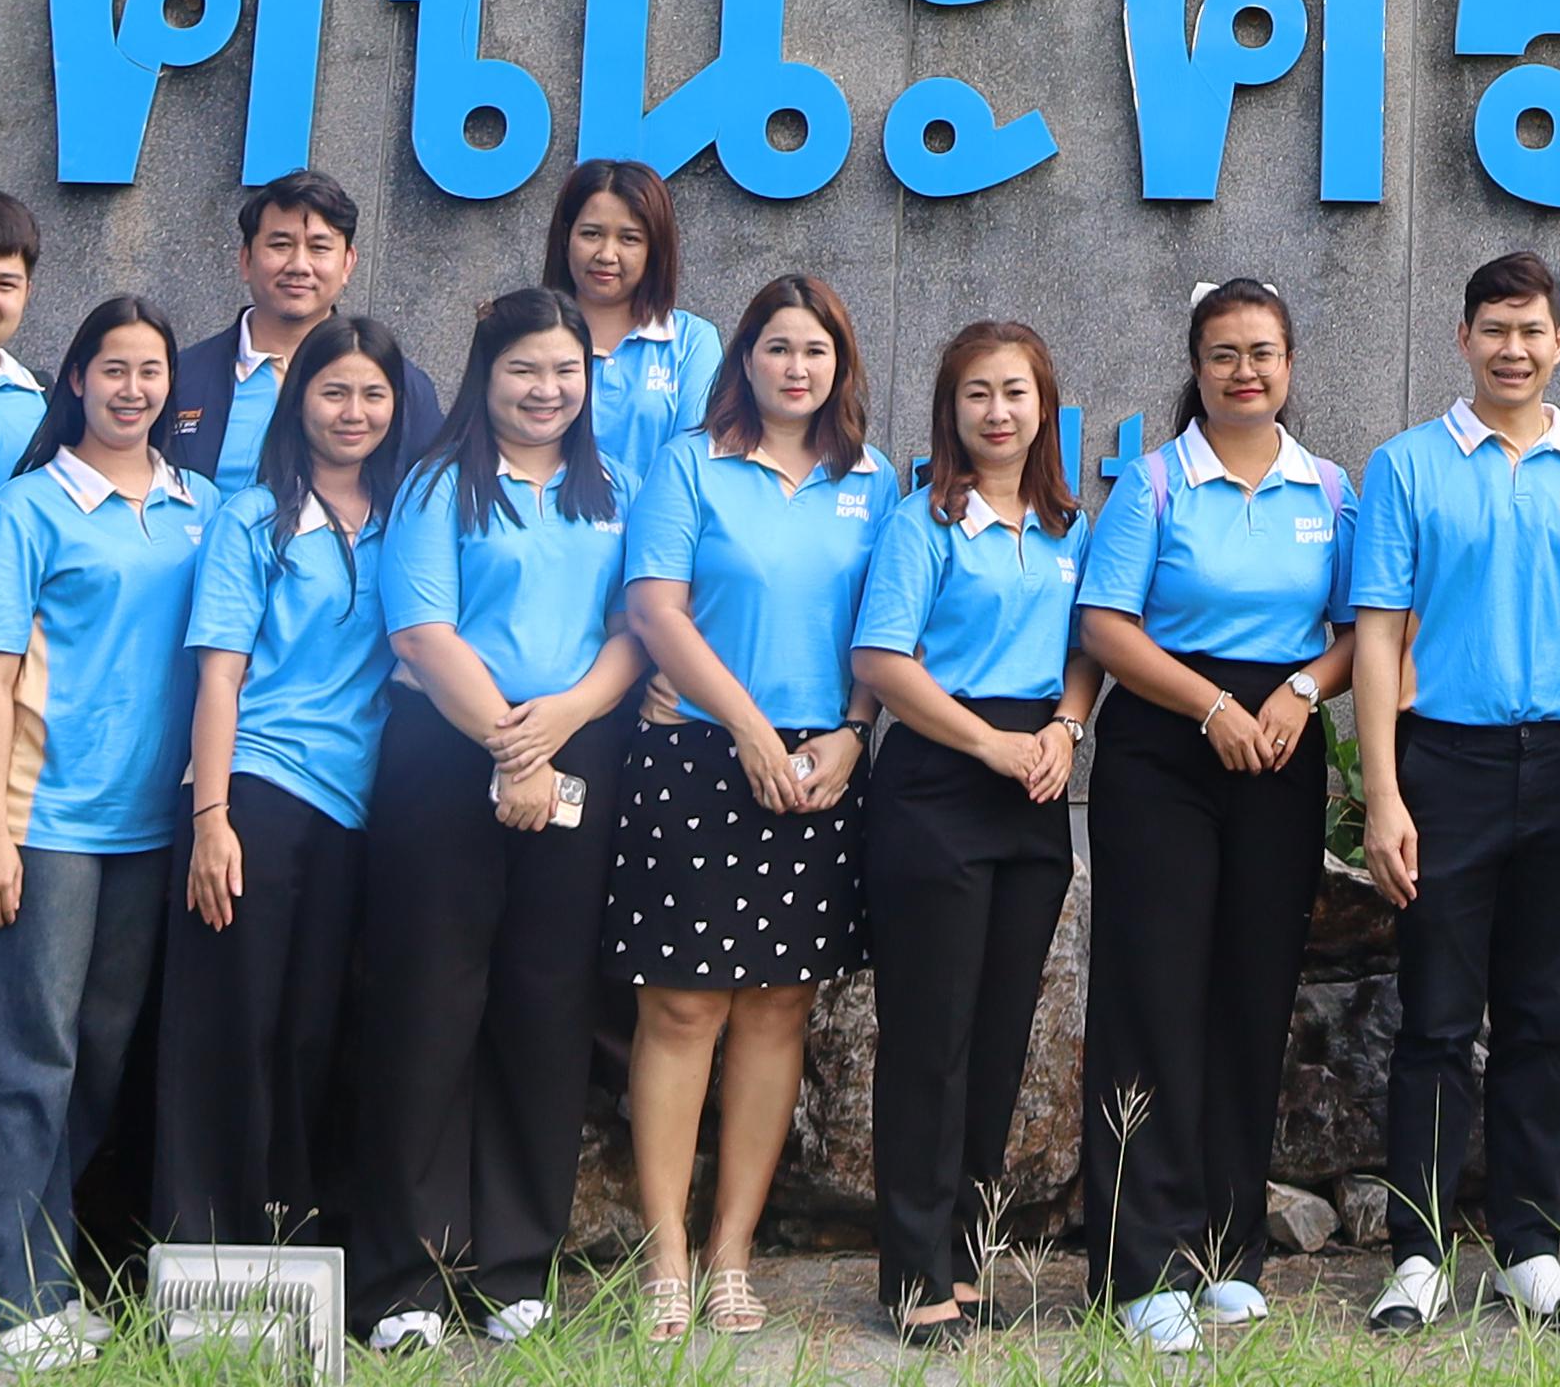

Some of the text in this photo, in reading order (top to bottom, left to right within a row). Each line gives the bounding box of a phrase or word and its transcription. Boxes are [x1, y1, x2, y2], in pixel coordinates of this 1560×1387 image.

[837, 492, 867, 506] EDU
[836, 505, 870, 522] KPRU
[1295, 517, 1323, 530] EDU
[1295, 529, 1333, 543] KPRU
